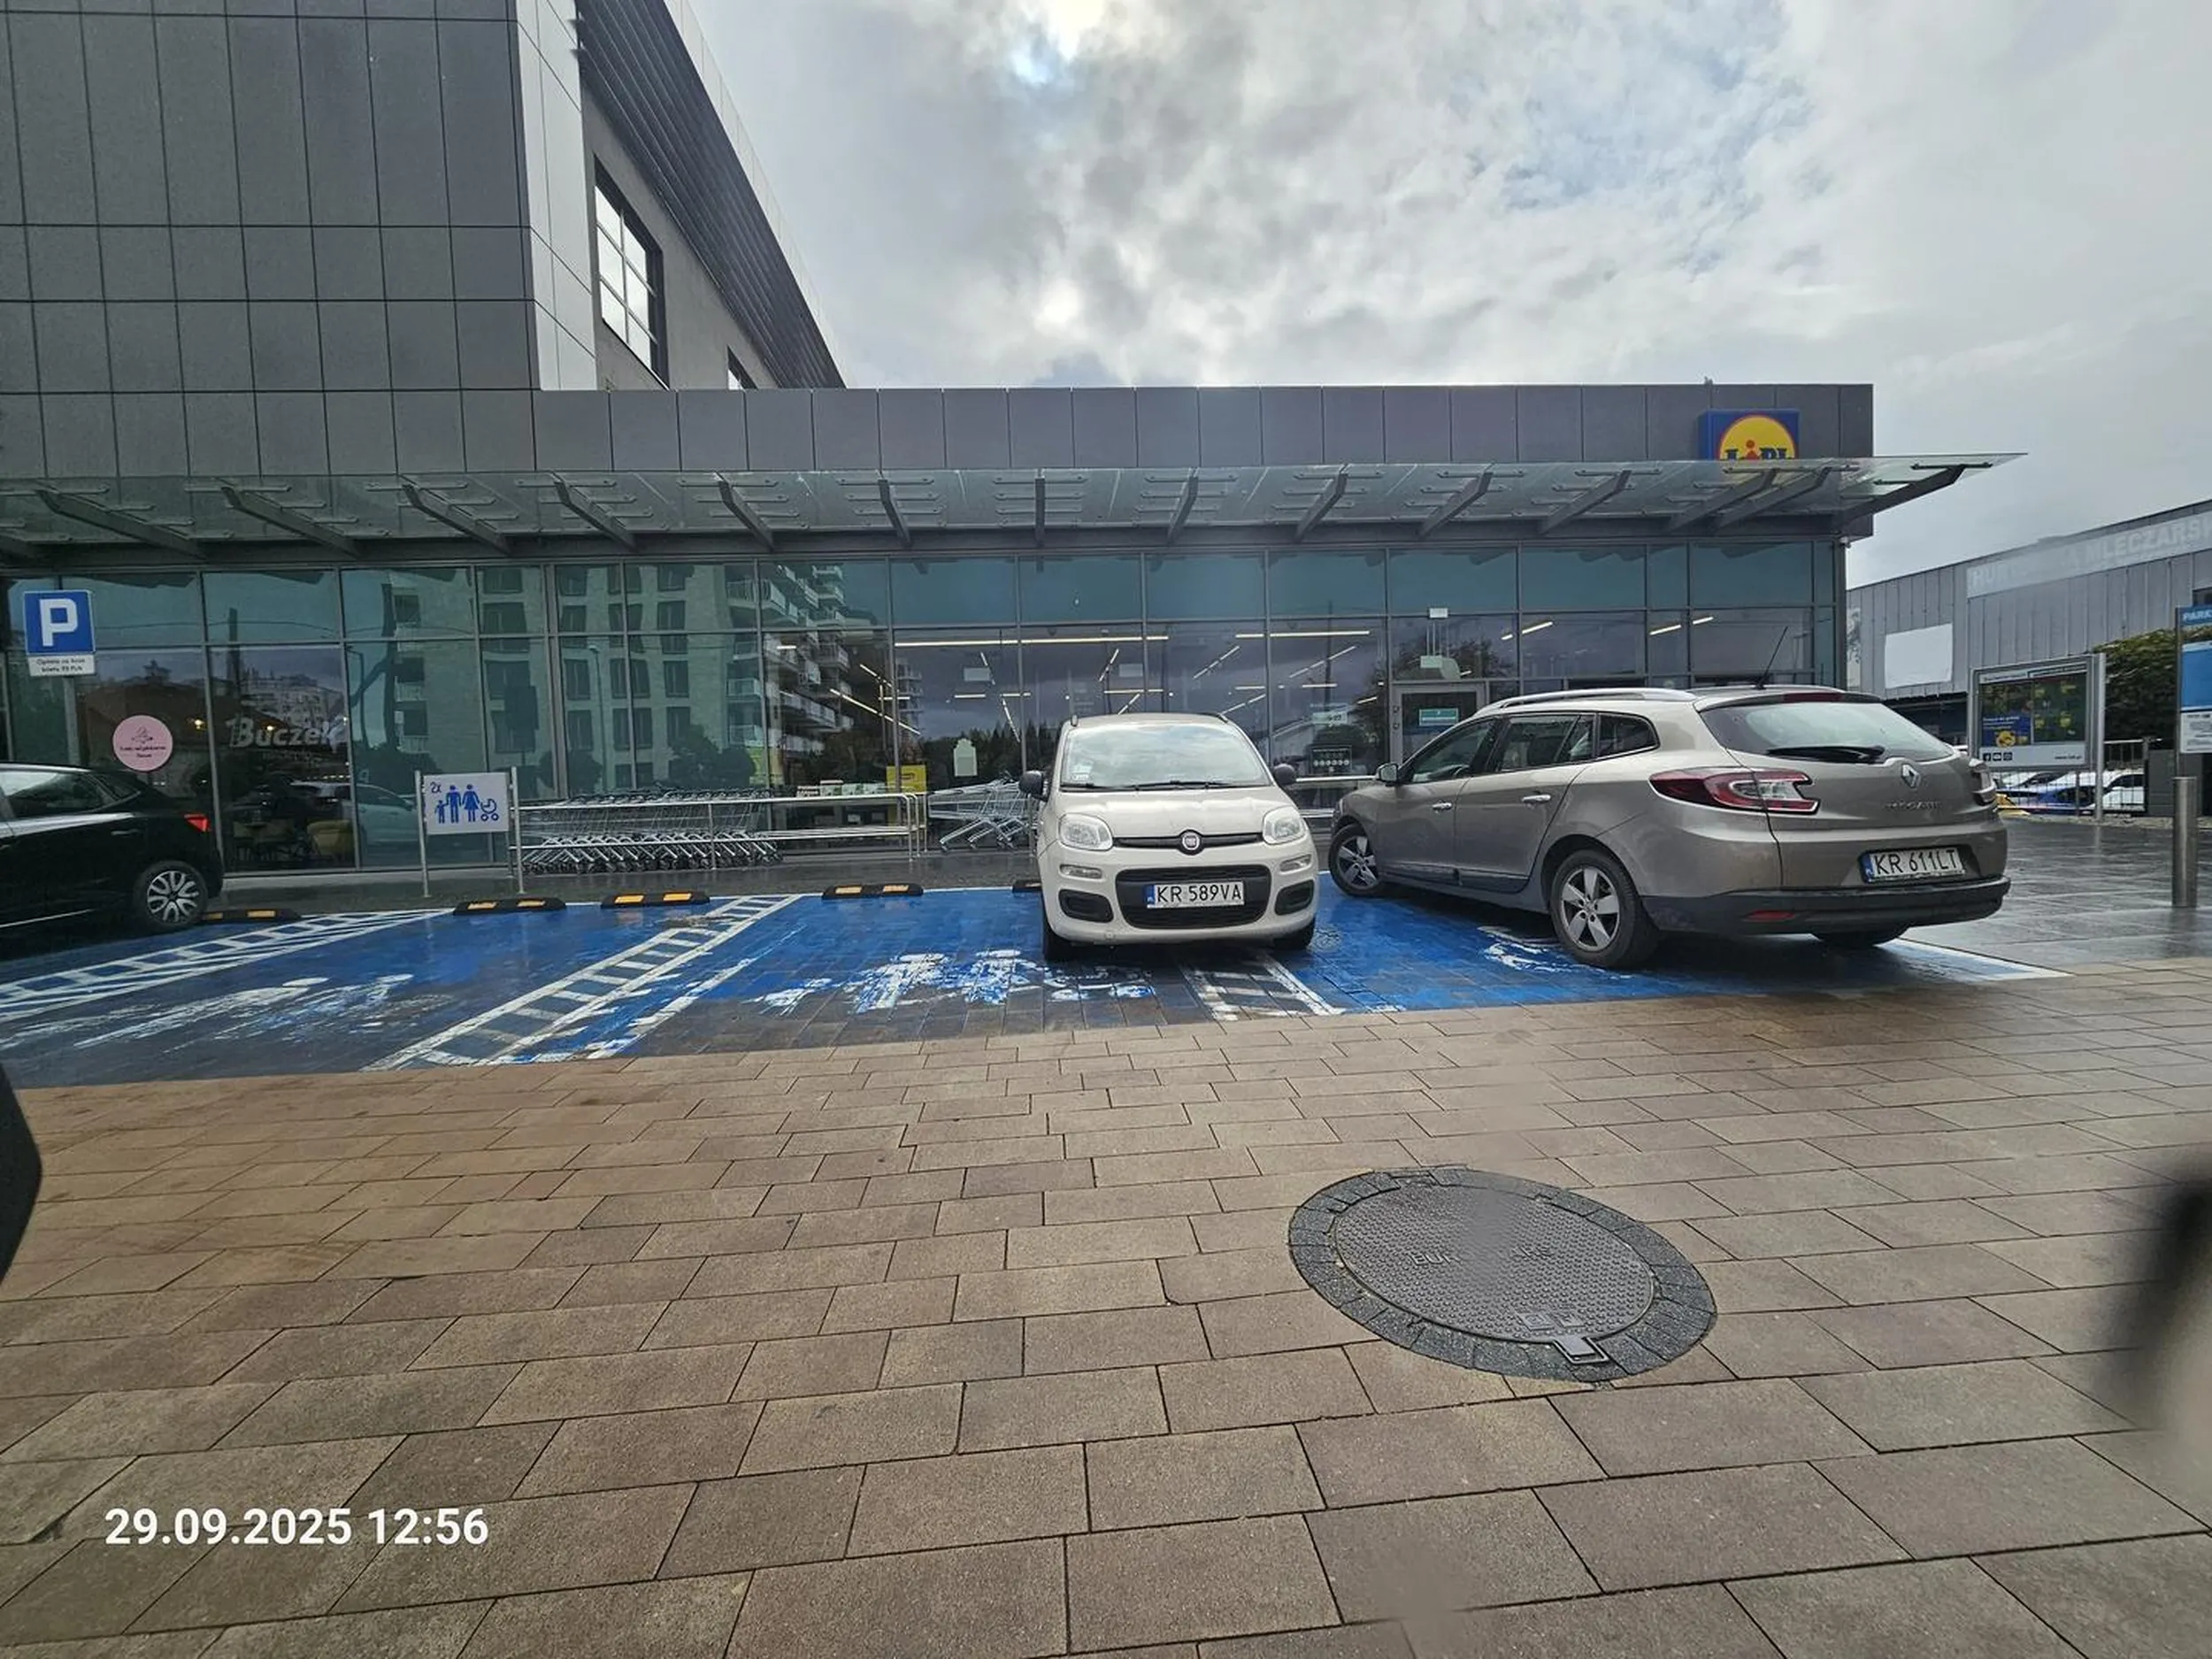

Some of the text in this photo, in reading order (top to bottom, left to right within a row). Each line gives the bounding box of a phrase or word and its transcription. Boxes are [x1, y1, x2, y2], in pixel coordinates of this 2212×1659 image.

[39, 598, 78, 647] P
[225, 714, 348, 753] Buczek
[1874, 849, 1957, 874] KR 611LT
[1157, 884, 1241, 902] KR 589VA
